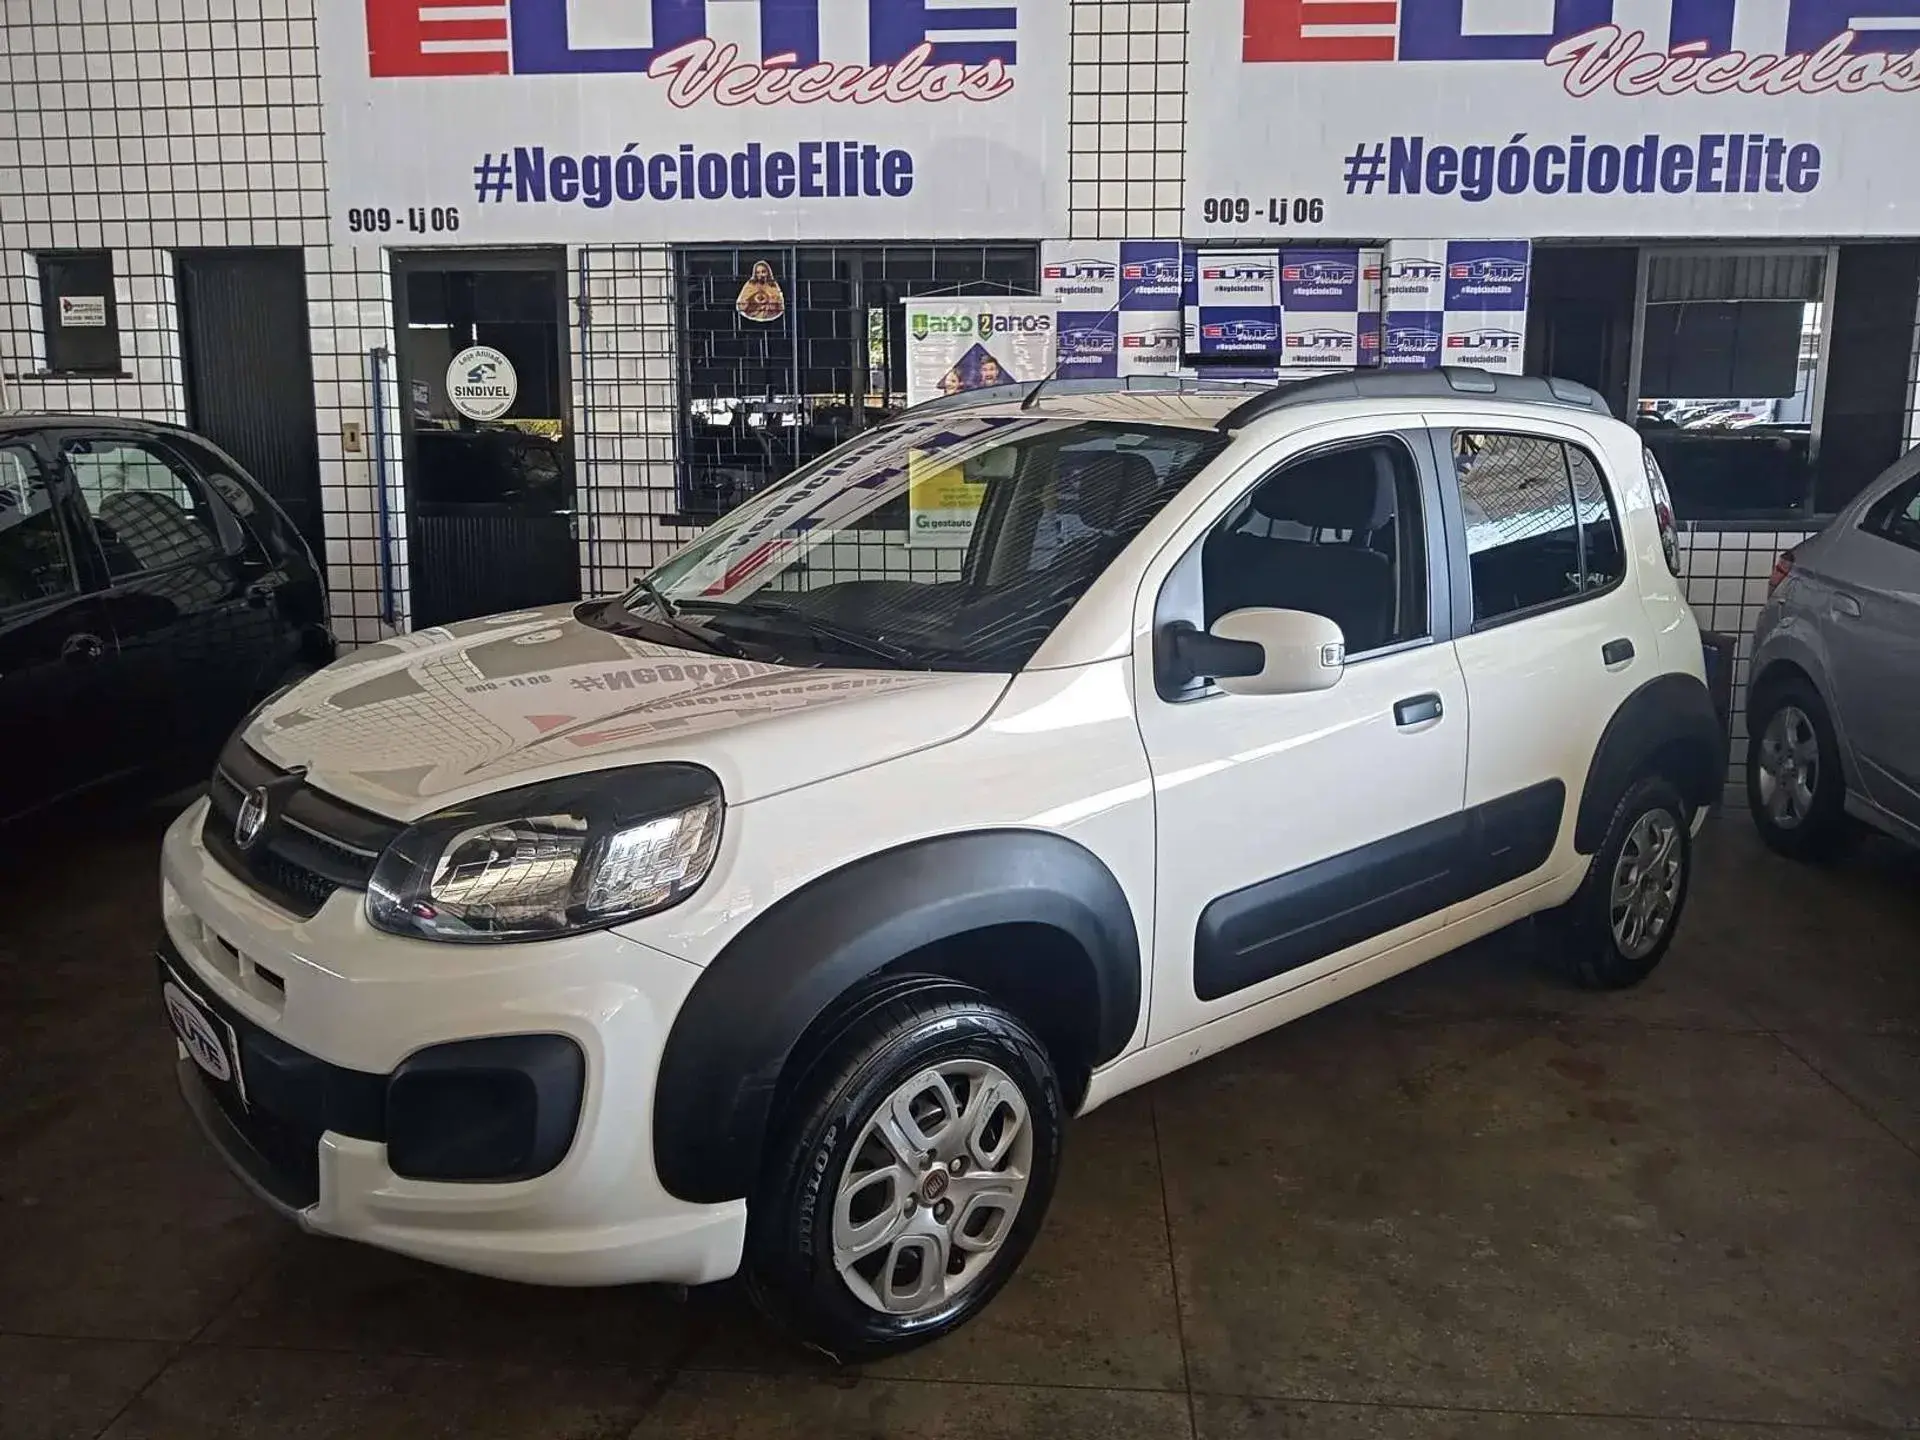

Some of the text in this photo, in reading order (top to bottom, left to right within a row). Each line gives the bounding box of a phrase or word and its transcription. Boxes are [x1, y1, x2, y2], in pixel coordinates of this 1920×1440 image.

[647, 38, 1015, 108] Veículos
[1544, 24, 1920, 98] Veículos
[473, 141, 914, 209] #NegóciodeElite
[1343, 133, 1821, 202] #NegóciodeElite
[348, 208, 391, 232] 909
[408, 207, 426, 234] Lj
[431, 207, 460, 231] 06
[1203, 198, 1250, 223] 909
[1269, 198, 1288, 225] Lj
[1293, 198, 1325, 223] 06
[929, 315, 973, 332] ano
[981, 316, 990, 332] 2
[994, 314, 1050, 332] anos
[455, 385, 510, 397] SINDIVEL
[931, 519, 972, 529] gestauto
